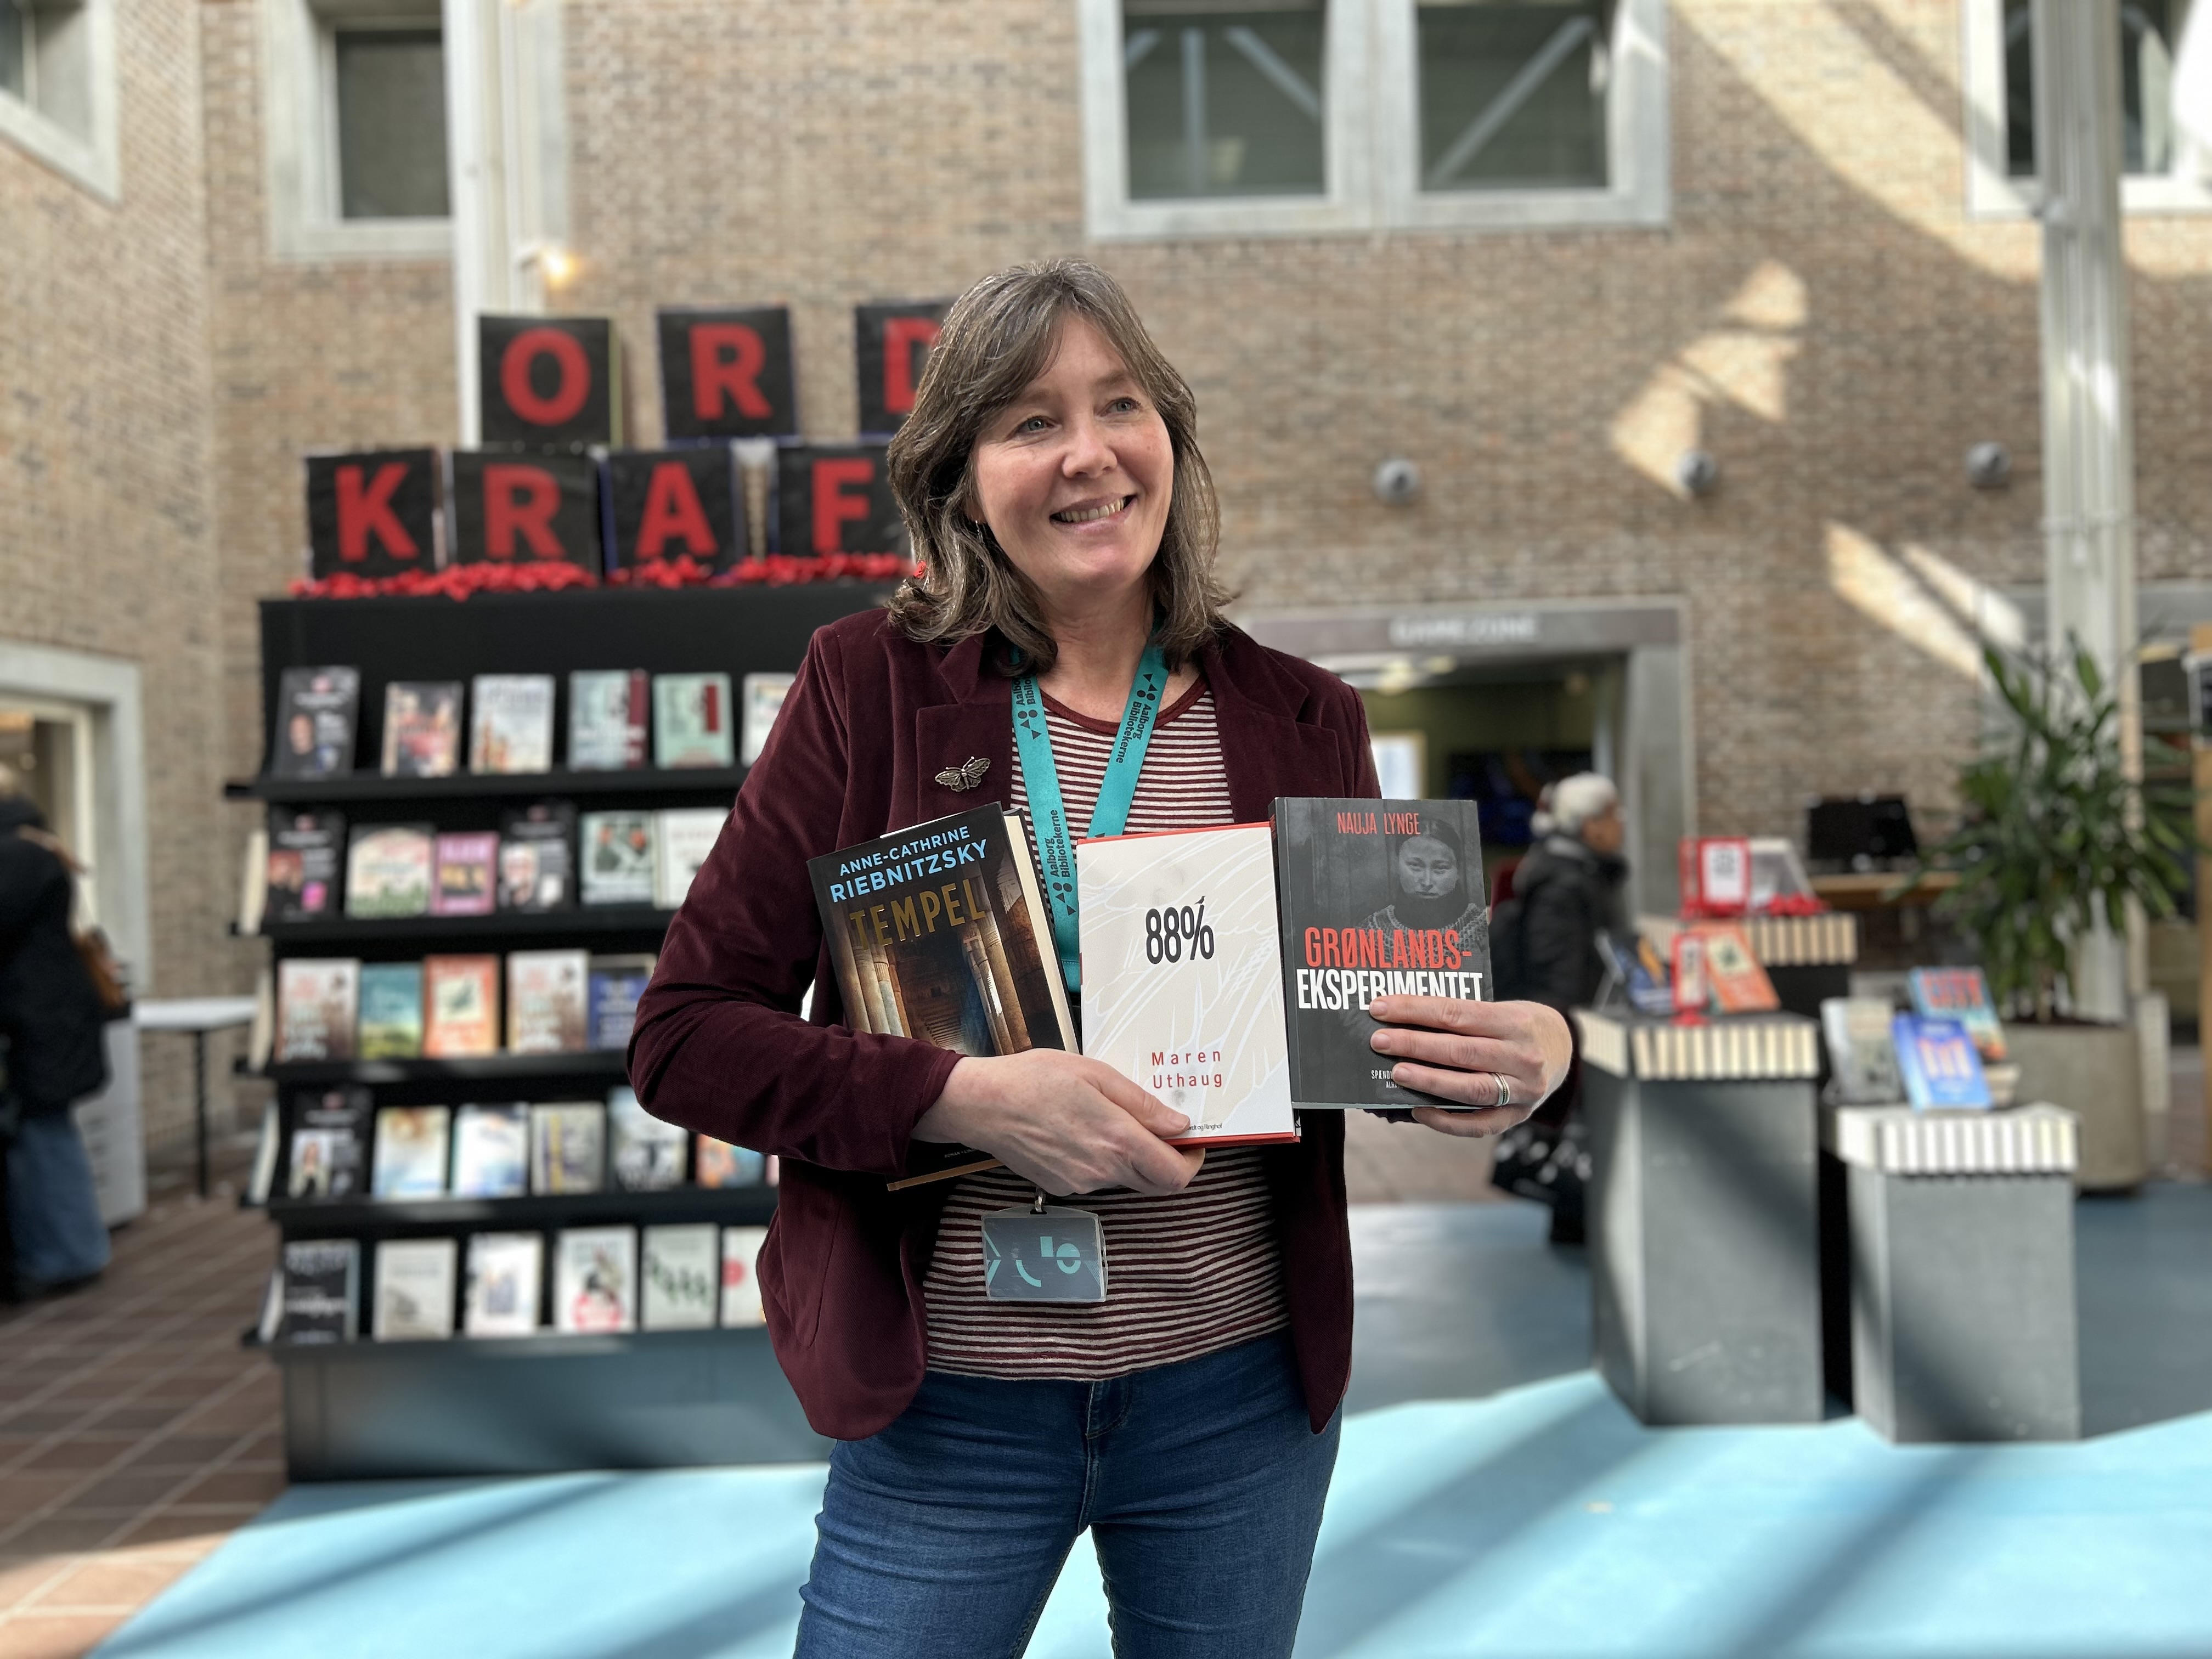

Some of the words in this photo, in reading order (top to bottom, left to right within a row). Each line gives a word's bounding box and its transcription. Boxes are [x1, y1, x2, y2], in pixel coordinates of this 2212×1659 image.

[1013, 678, 1025, 706] Aalbo
[1023, 677, 1036, 705] Biblio
[1116, 701, 1142, 763] Bibliotekerne
[1133, 703, 1152, 740] Aalborg
[1050, 810, 1071, 877] Bibliotekerne
[1337, 812, 1378, 834] NAUJA
[1384, 812, 1421, 835] LYNGE
[830, 839, 988, 903] RIEBNITZSKY
[839, 826, 970, 877] ANNE-CATHRINE
[1045, 838, 1060, 877] Aalborg
[850, 879, 986, 951] TEMPEL
[1145, 904, 1215, 964] 88%
[1305, 927, 1472, 970] GRØNLANDS-
[1296, 969, 1483, 1011] EKSPERIMENTET
[1152, 1049, 1221, 1066] Maren
[1153, 1072, 1223, 1089] Uthaug
